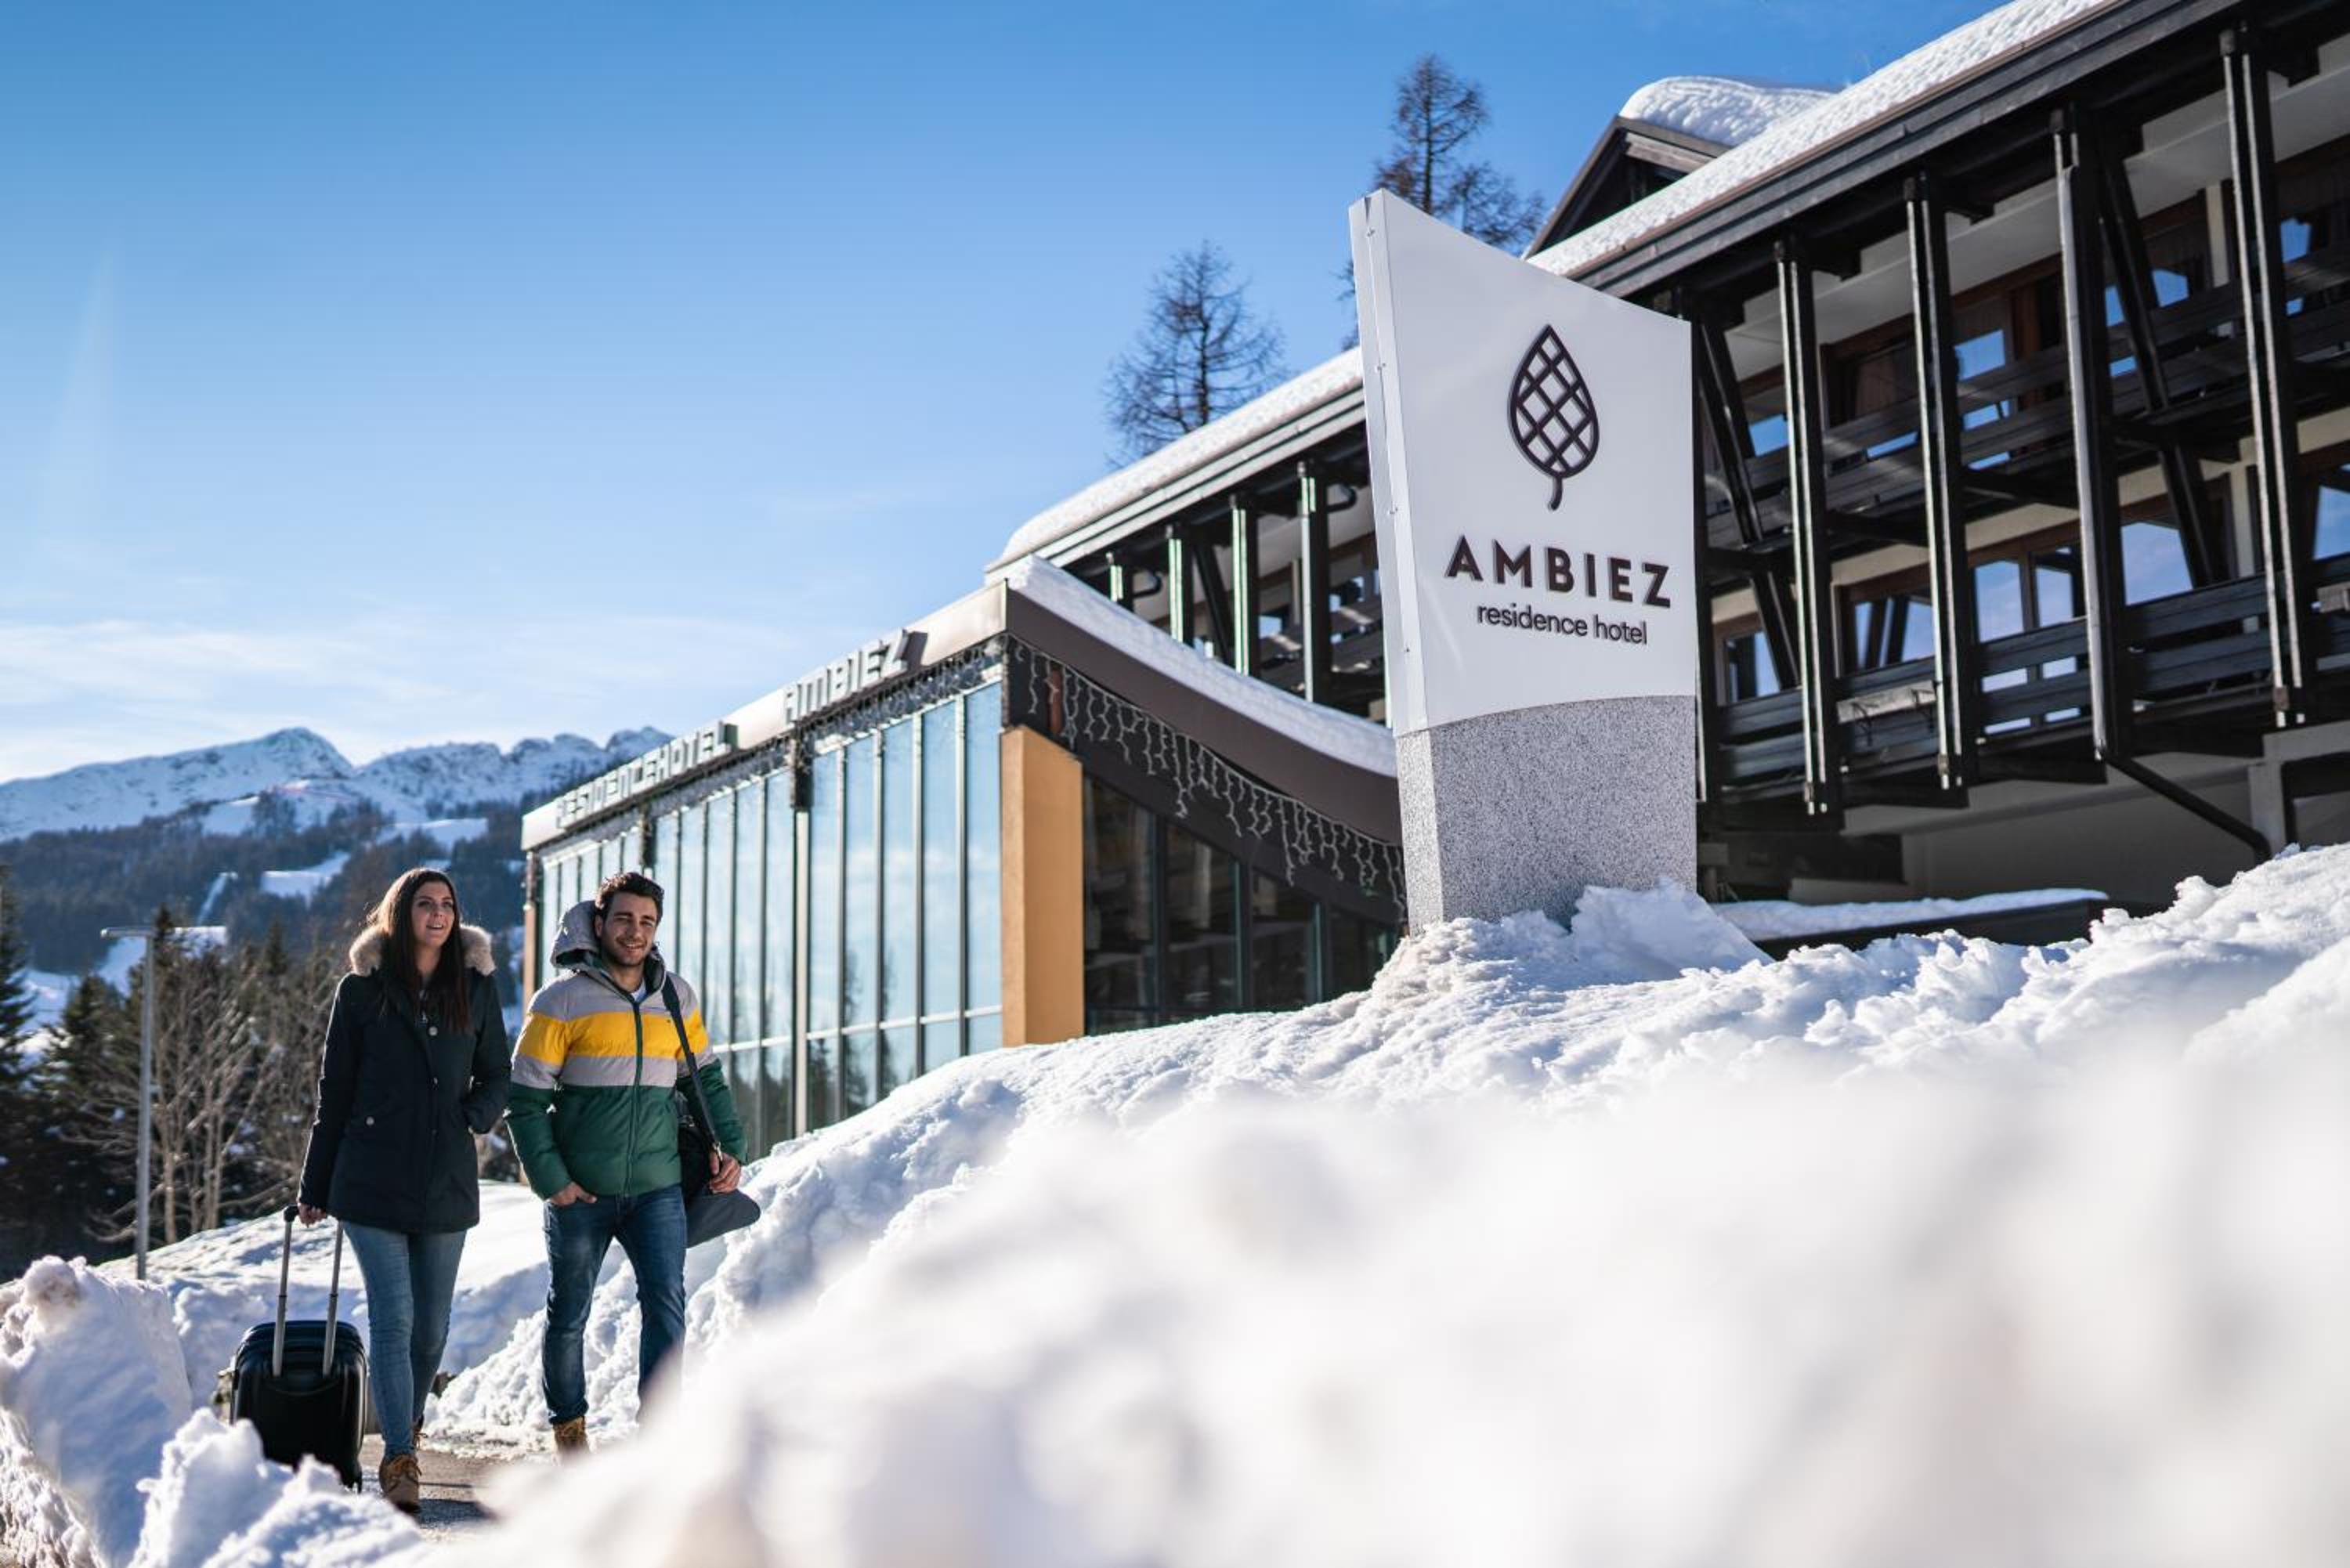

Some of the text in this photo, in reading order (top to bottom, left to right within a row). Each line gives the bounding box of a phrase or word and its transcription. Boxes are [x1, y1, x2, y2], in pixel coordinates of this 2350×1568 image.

[1444, 534, 1671, 609] AMBIEZ
[1477, 603, 1647, 645] residence hotel
[783, 627, 909, 725] AMBIEZ
